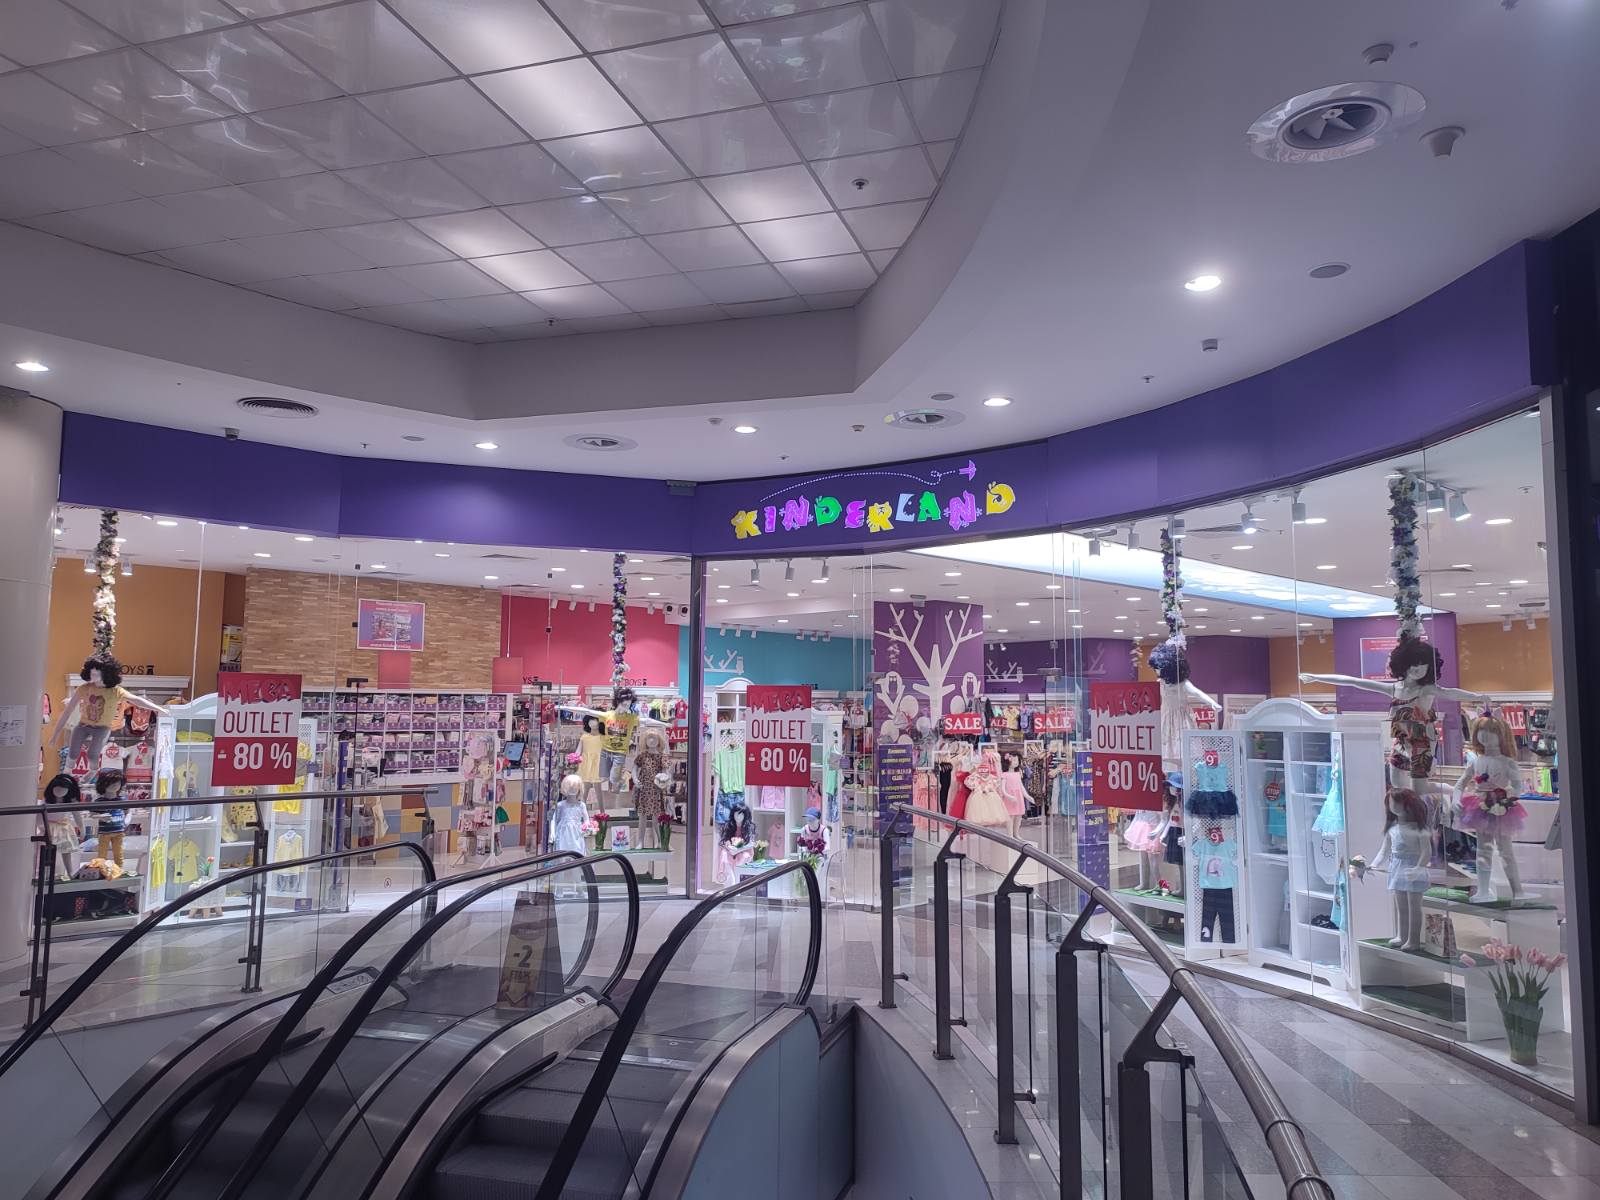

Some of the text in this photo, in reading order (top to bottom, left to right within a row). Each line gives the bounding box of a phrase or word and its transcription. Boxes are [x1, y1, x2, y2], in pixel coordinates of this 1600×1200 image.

[731, 481, 1016, 539] KINDERLAND
[120, 665, 145, 675] OYS
[223, 711, 294, 734] OUTLET
[944, 717, 982, 730] SALE
[990, 718, 1009, 728] ALE
[1034, 717, 1072, 730] SALE
[1193, 710, 1215, 721] ALE
[1504, 711, 1526, 730] ALE
[751, 719, 806, 740] OUTLET
[1097, 724, 1155, 751] OUTLET
